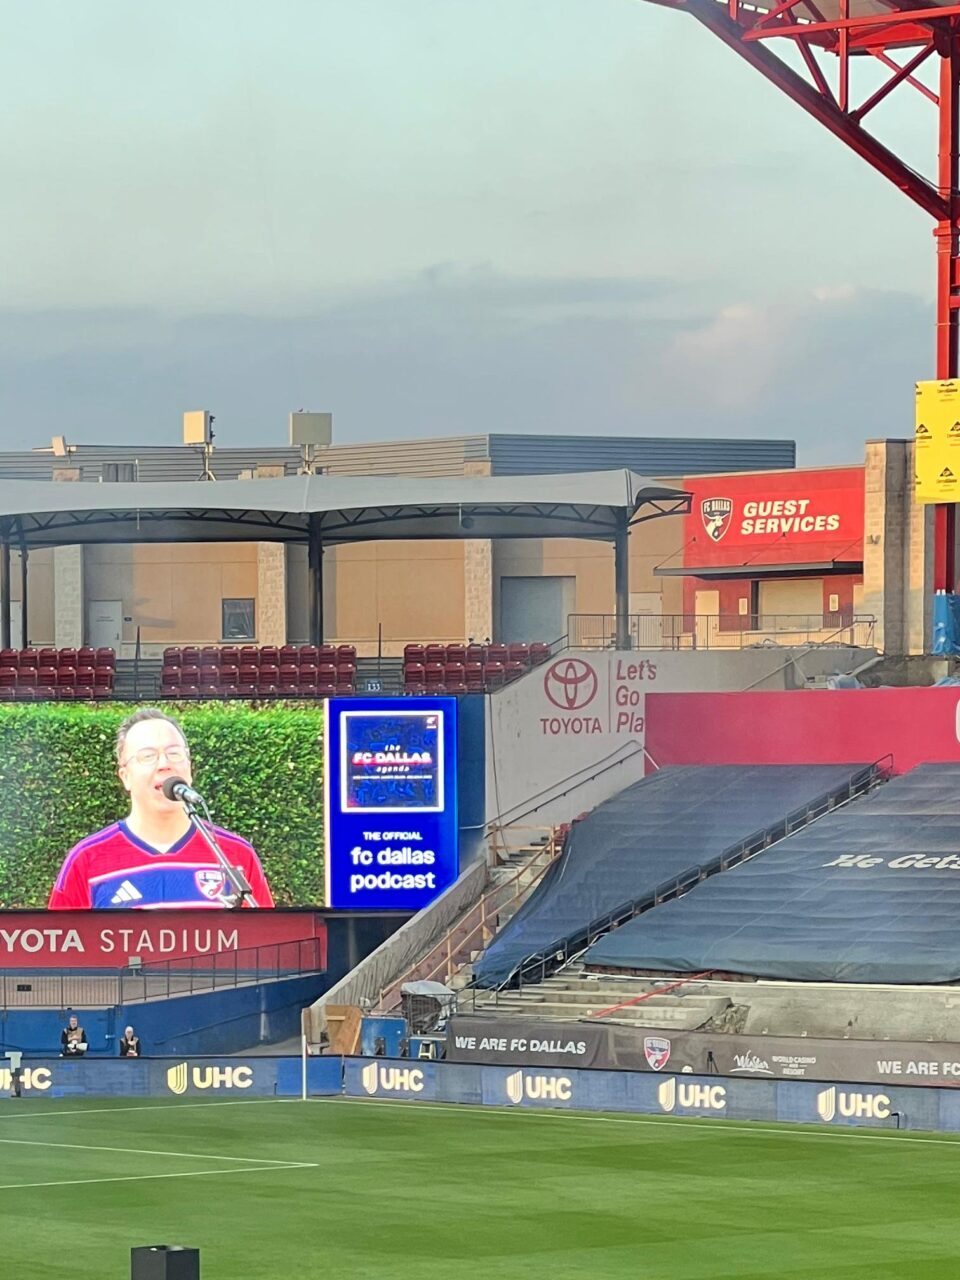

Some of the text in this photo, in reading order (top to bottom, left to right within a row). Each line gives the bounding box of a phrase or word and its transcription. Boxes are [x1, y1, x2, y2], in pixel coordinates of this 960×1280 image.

[743, 500, 810, 517] GUEST
[741, 515, 840, 535] SERVICES
[616, 659, 657, 681] Let's
[616, 685, 640, 706] Go
[540, 717, 602, 735] TOYOTA
[353, 752, 431, 764] FC DALLAS
[363, 831, 423, 841] THE OFFICIAL
[351, 847, 435, 865] fc dallas
[822, 853, 960, 870] He Gets
[350, 871, 436, 892] podcast
[99, 929, 239, 952] STADIUM
[455, 1036, 586, 1054] WE ARE FC DALLAS
[192, 1066, 253, 1089] UHC
[876, 1061, 960, 1076] WE ARE FC
[380, 1067, 424, 1092] UHC
[525, 1076, 572, 1100] UHC
[678, 1084, 726, 1109] UHC
[839, 1092, 891, 1118] UHC
